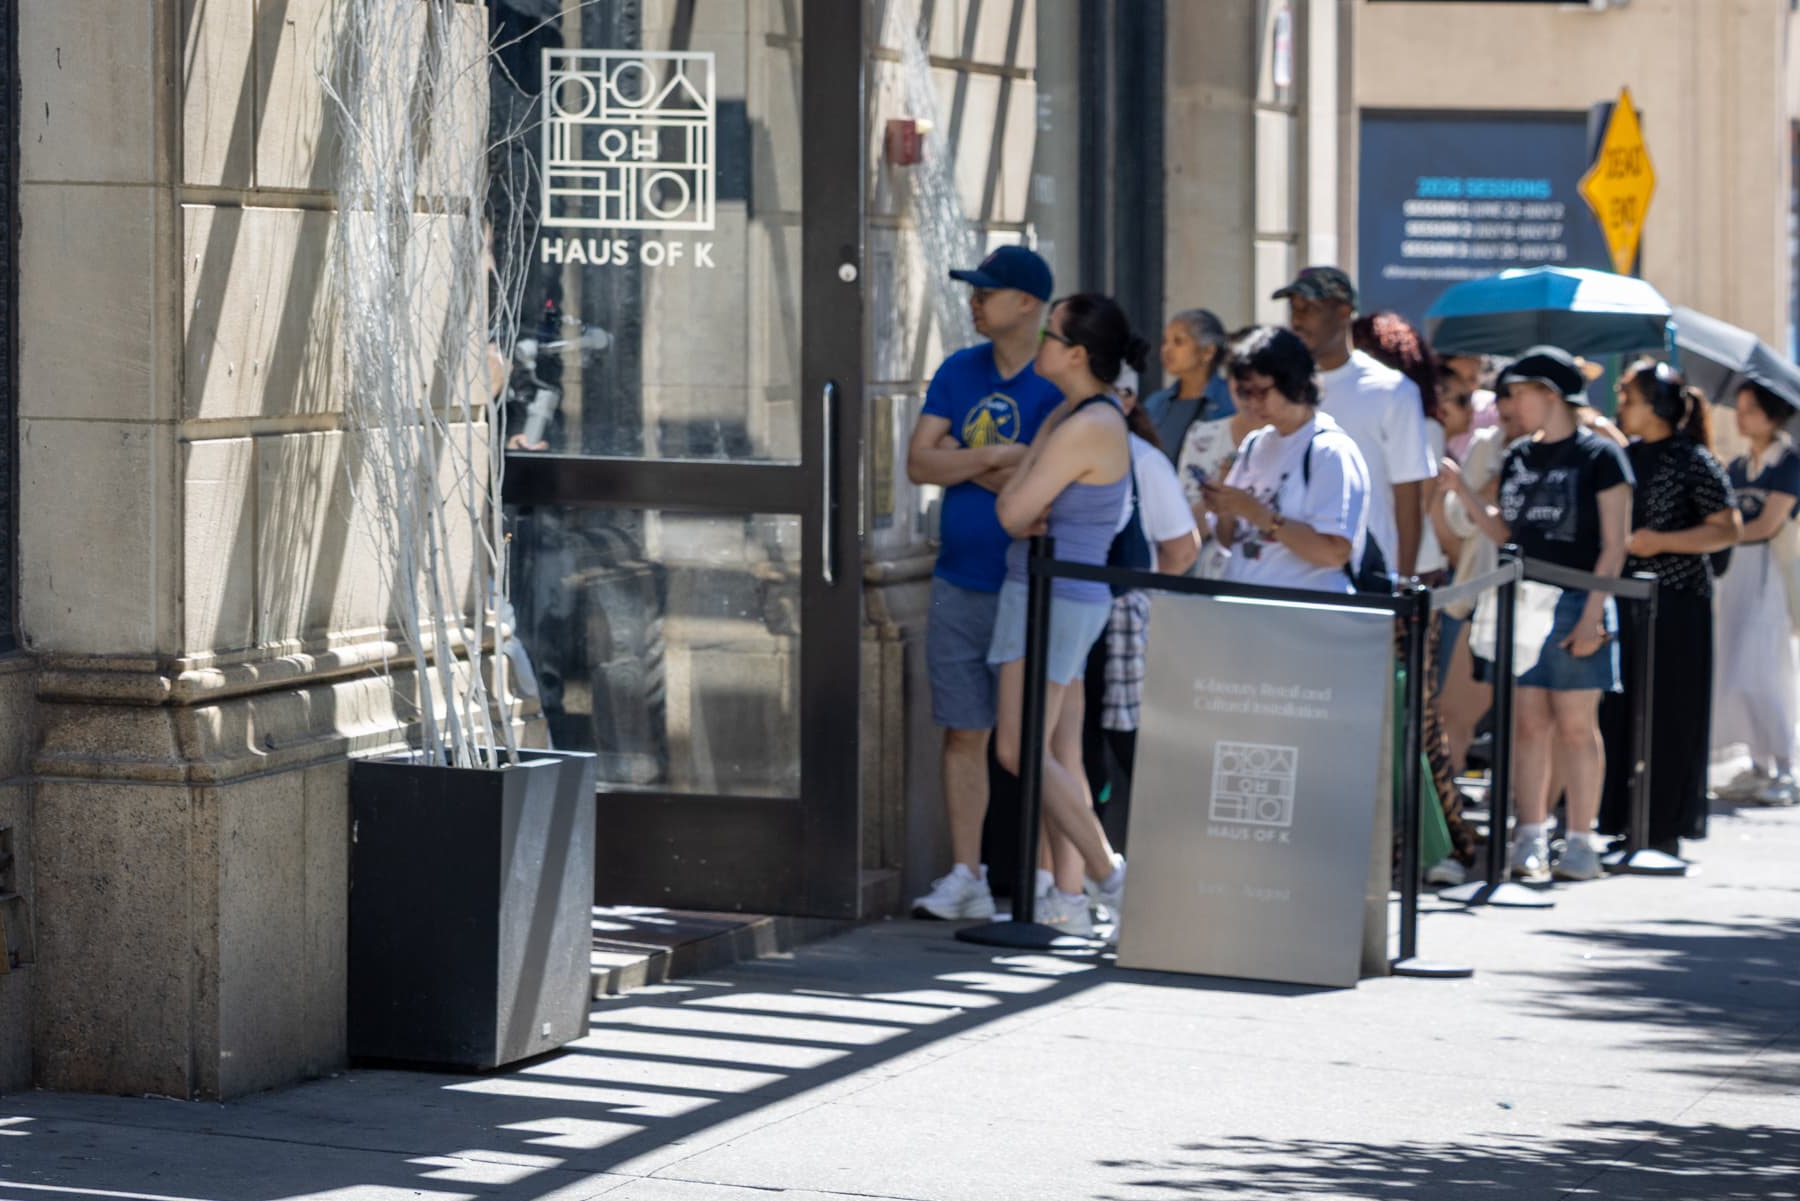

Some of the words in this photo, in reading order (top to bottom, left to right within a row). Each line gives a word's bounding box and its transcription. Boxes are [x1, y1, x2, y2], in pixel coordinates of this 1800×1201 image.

[541, 237, 629, 266] HAUS
[639, 240, 683, 268] OF
[694, 241, 715, 268] K
[1207, 825, 1249, 841] HAUS
[1253, 829, 1276, 842] OF
